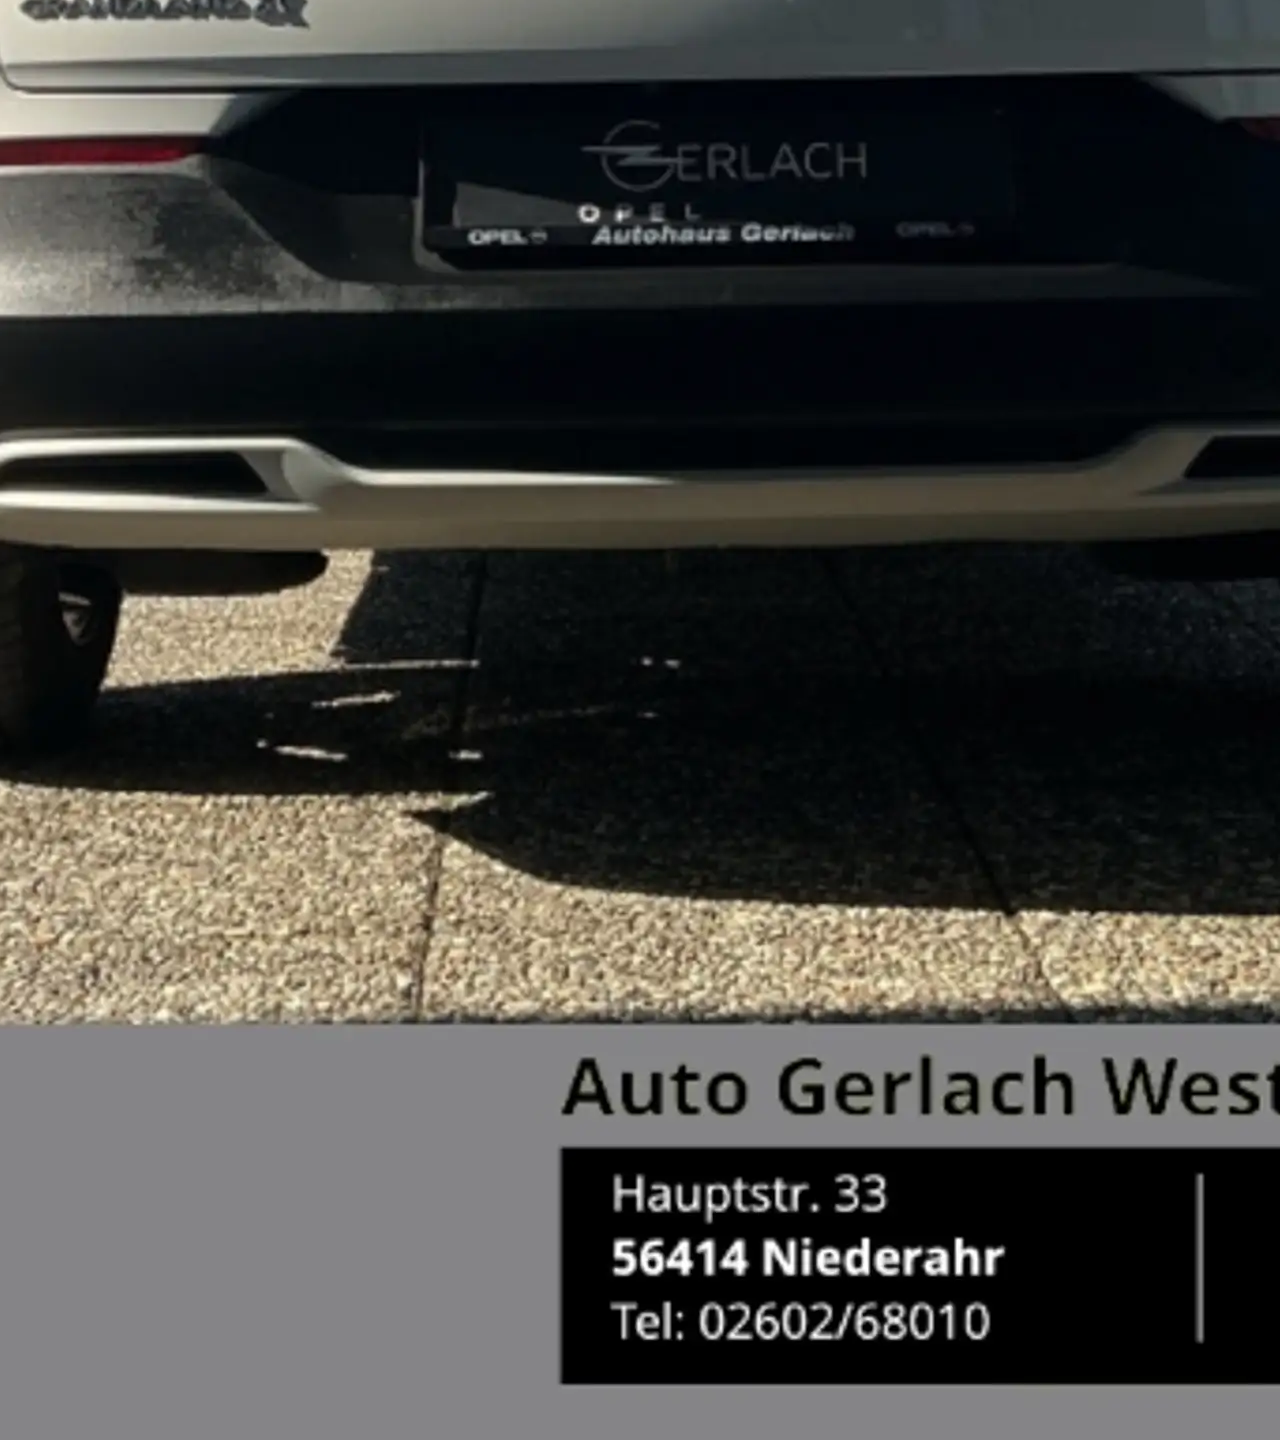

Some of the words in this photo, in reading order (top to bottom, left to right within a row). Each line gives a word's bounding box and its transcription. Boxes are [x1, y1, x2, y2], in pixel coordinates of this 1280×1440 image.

[577, 202, 703, 224] OPEL
[592, 224, 732, 247] Autohaus
[740, 221, 857, 243] Gerlach
